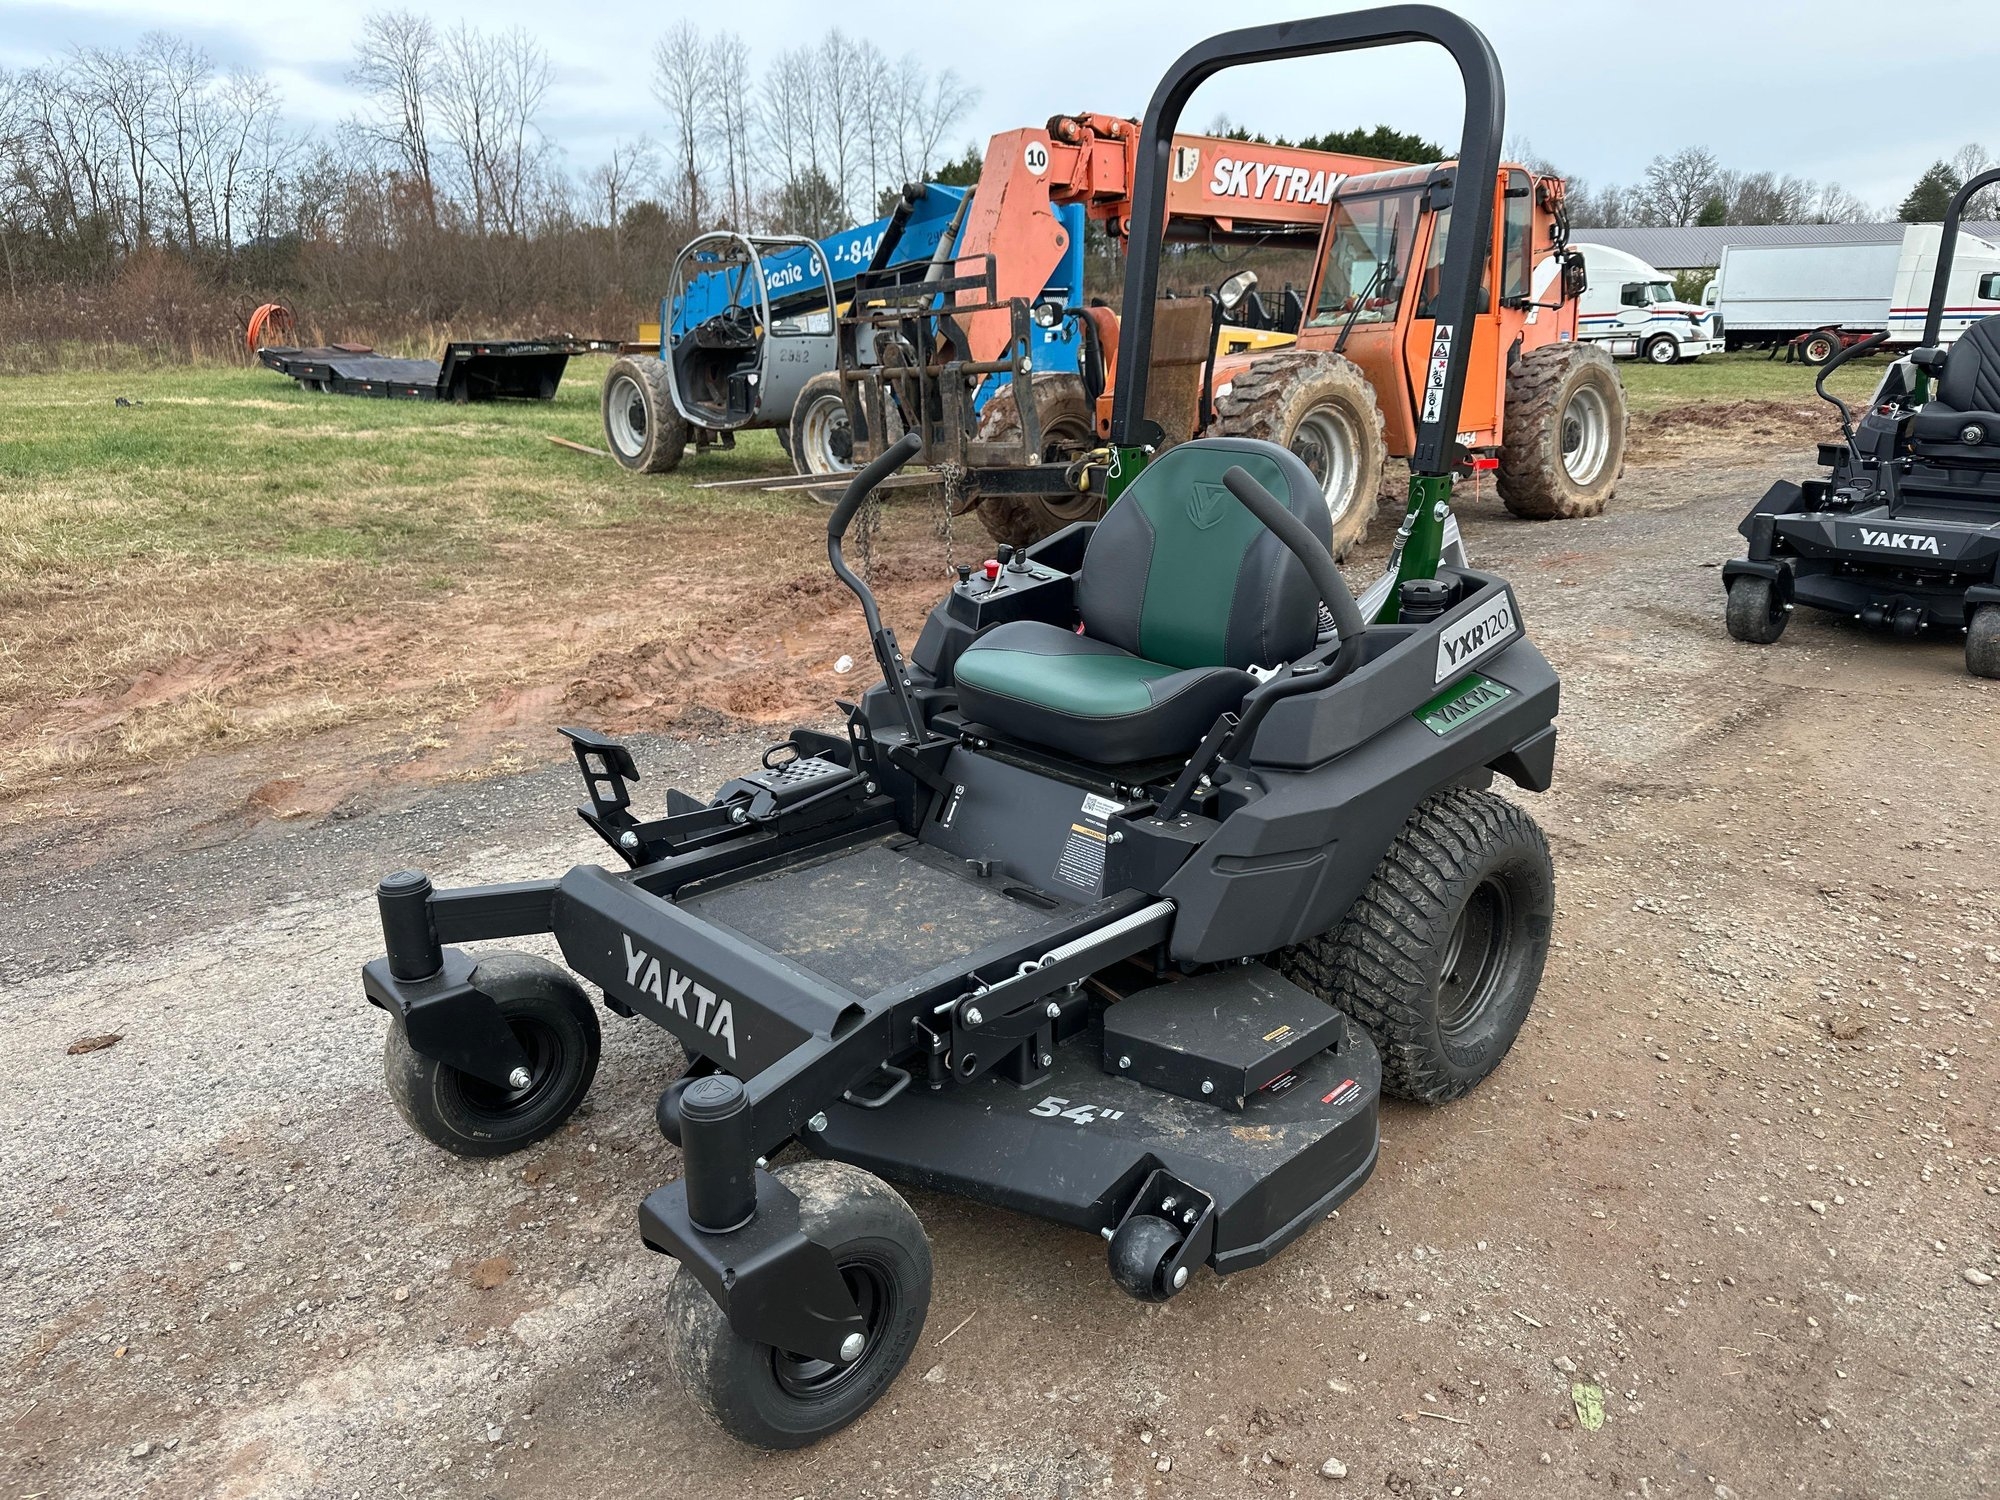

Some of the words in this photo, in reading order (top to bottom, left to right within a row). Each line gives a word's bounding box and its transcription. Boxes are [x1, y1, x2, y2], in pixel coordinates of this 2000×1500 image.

[1028, 149, 1046, 167] 10
[1859, 527, 1940, 555] YAKTA
[1443, 608, 1509, 666] YXR120
[1426, 686, 1502, 725] YAKTA
[622, 932, 737, 1060] YAKTA
[1028, 1095, 1125, 1125] 54"
